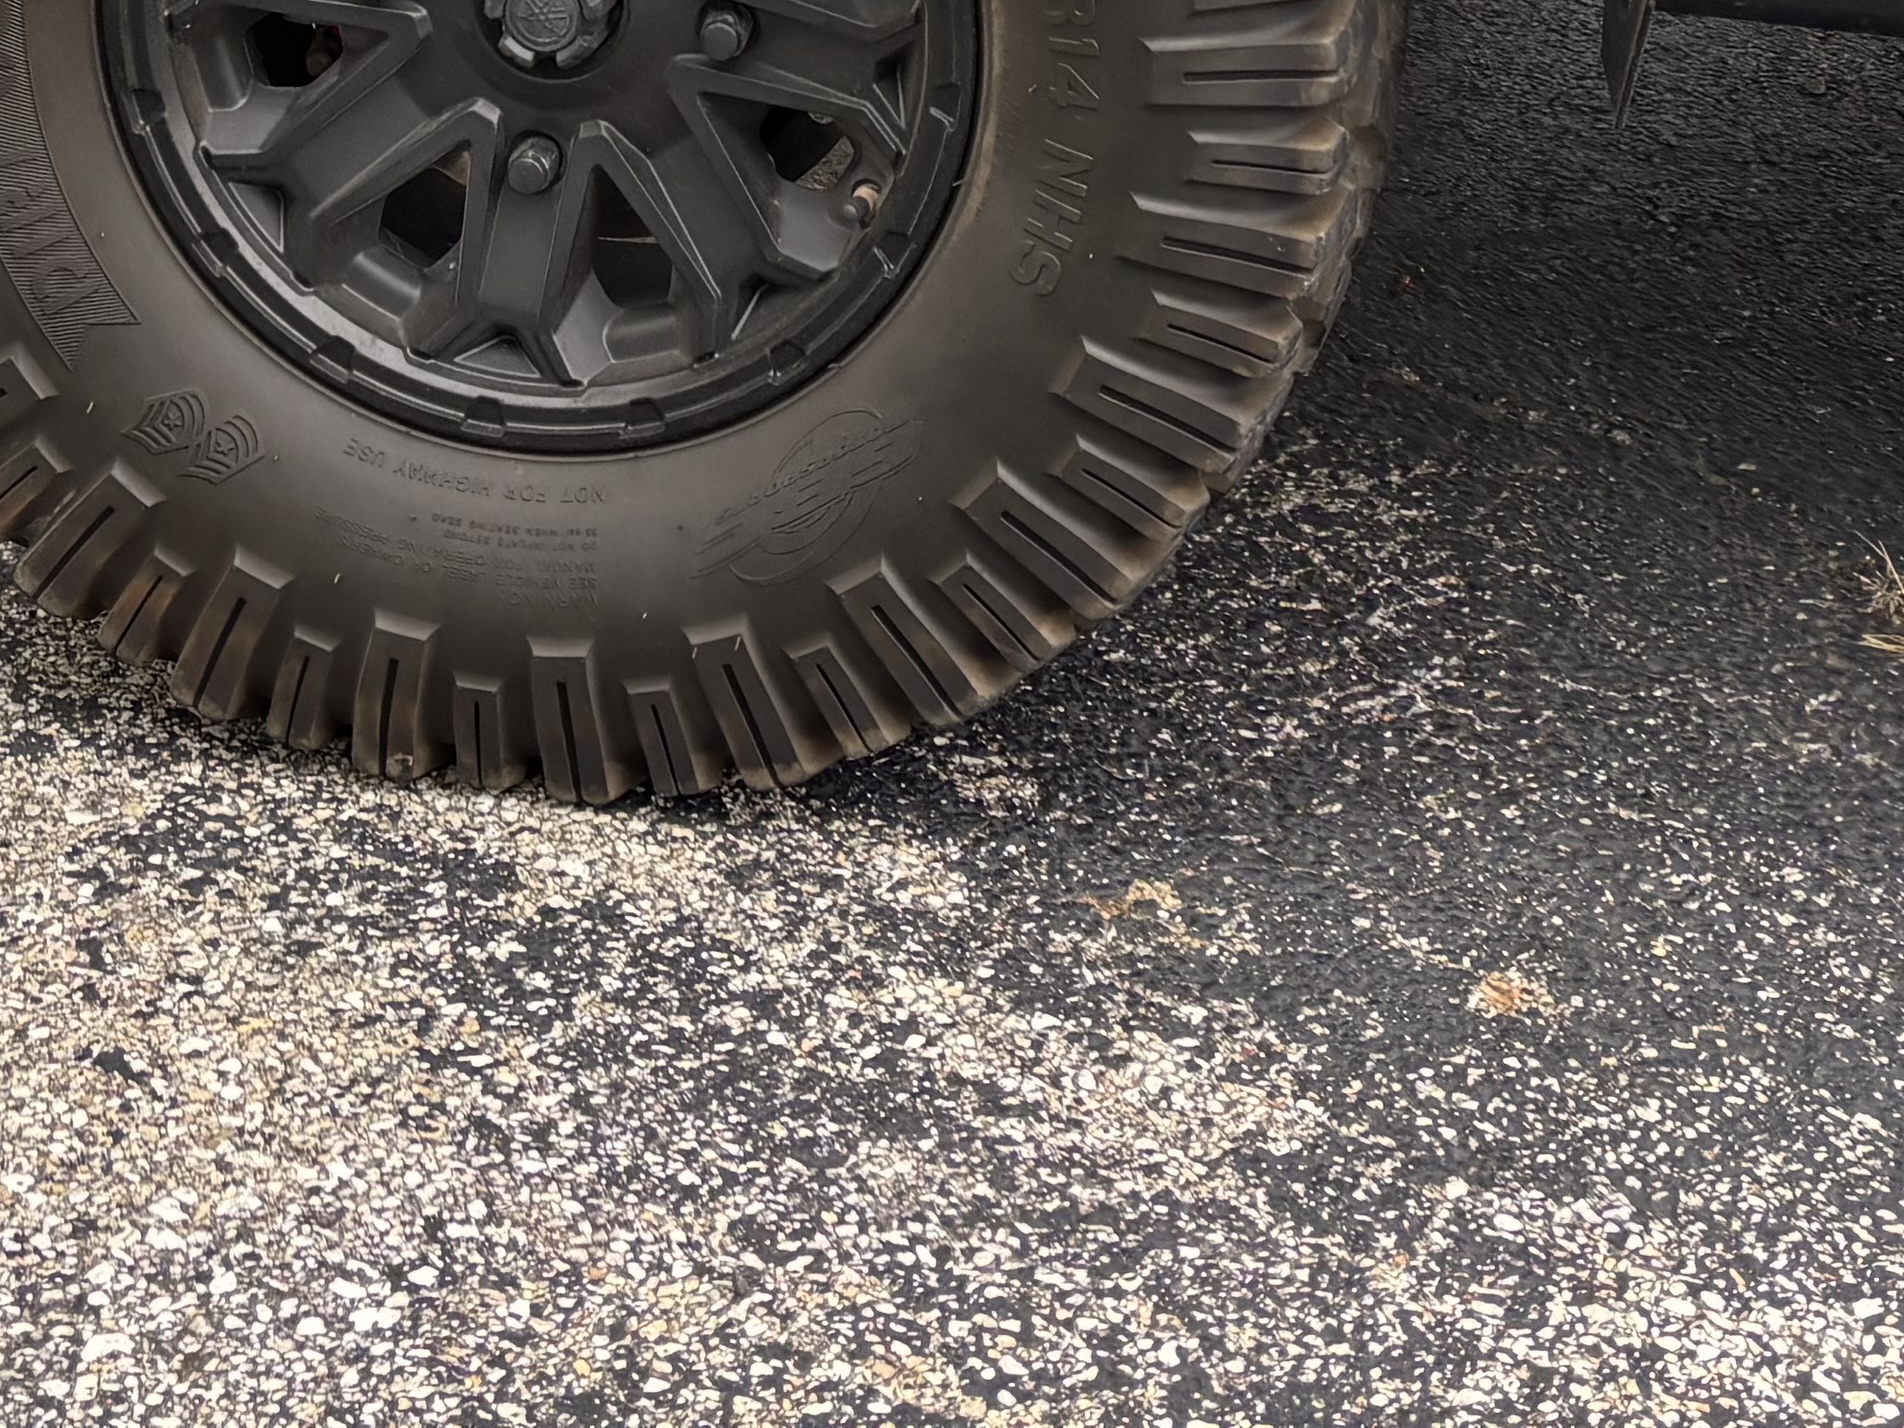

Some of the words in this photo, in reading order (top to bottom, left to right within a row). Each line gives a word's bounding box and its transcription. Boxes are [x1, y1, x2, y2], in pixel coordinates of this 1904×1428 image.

[1009, 137, 1094, 297] NHS
[343, 437, 385, 468] USE
[392, 460, 490, 497] HIGHWAY
[503, 484, 546, 503] FOR
[560, 486, 606, 504] NOT
